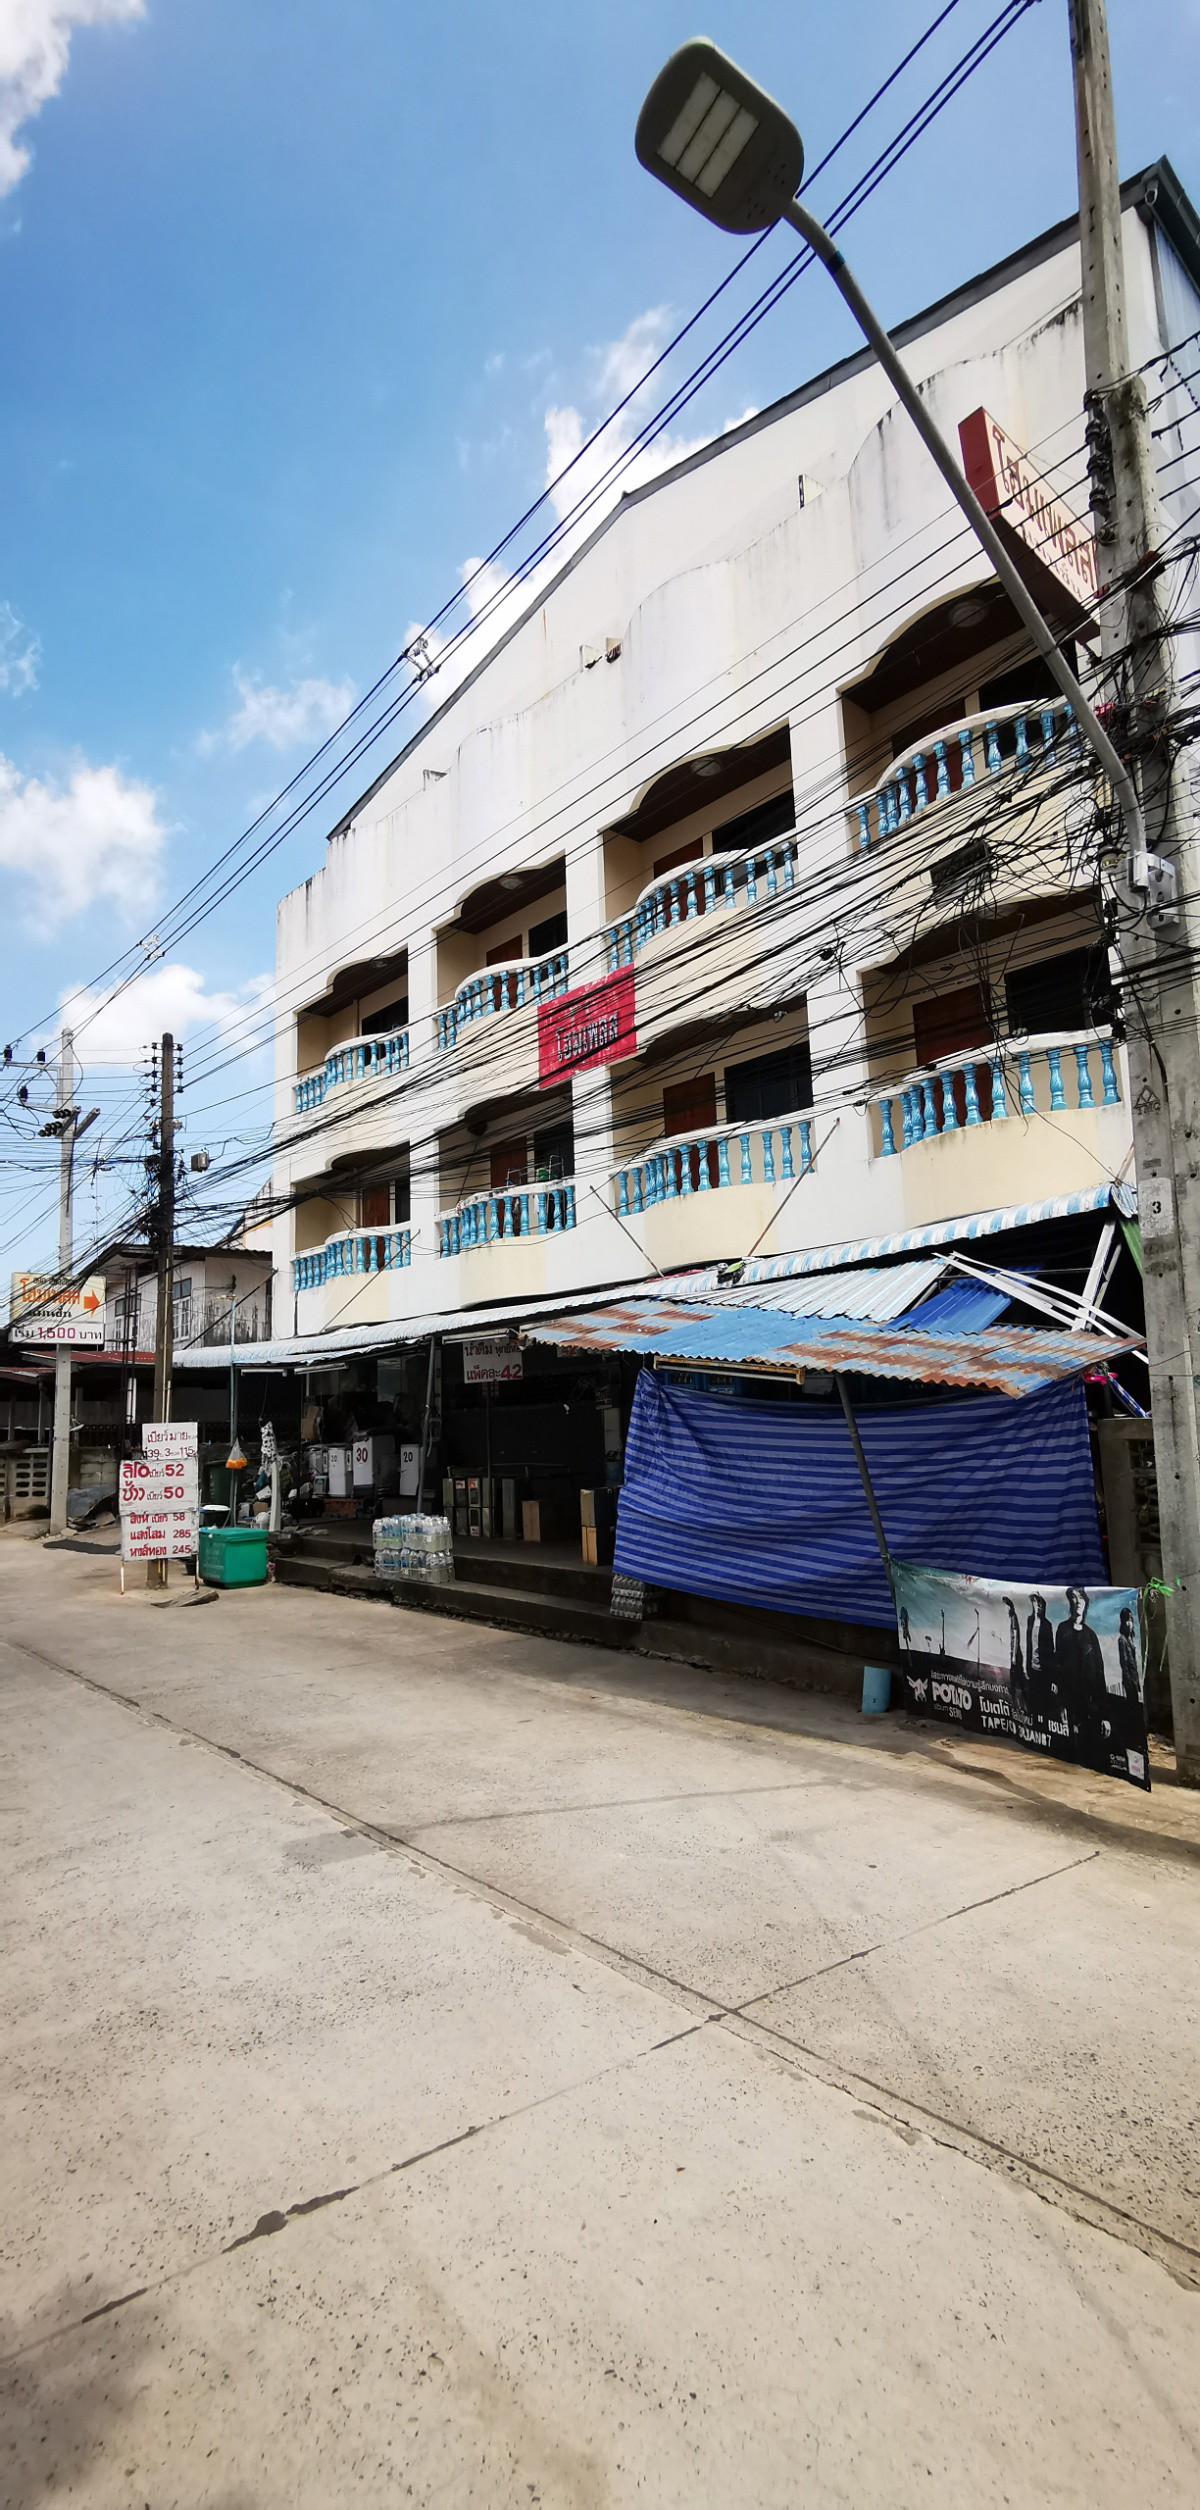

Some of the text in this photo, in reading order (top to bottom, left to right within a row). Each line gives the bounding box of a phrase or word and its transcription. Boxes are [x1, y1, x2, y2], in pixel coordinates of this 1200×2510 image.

[1151, 1200, 1162, 1214] 3
[37, 1327, 76, 1340] 1,500
[79, 1331, 102, 1340] บาท
[356, 1447, 368, 1463] 30
[403, 1451, 413, 1463] 20
[165, 1463, 185, 1477] 52
[163, 1486, 185, 1499] 50
[172, 1512, 185, 1522] 58
[172, 1529, 191, 1539] 285
[172, 1544, 191, 1555] 245
